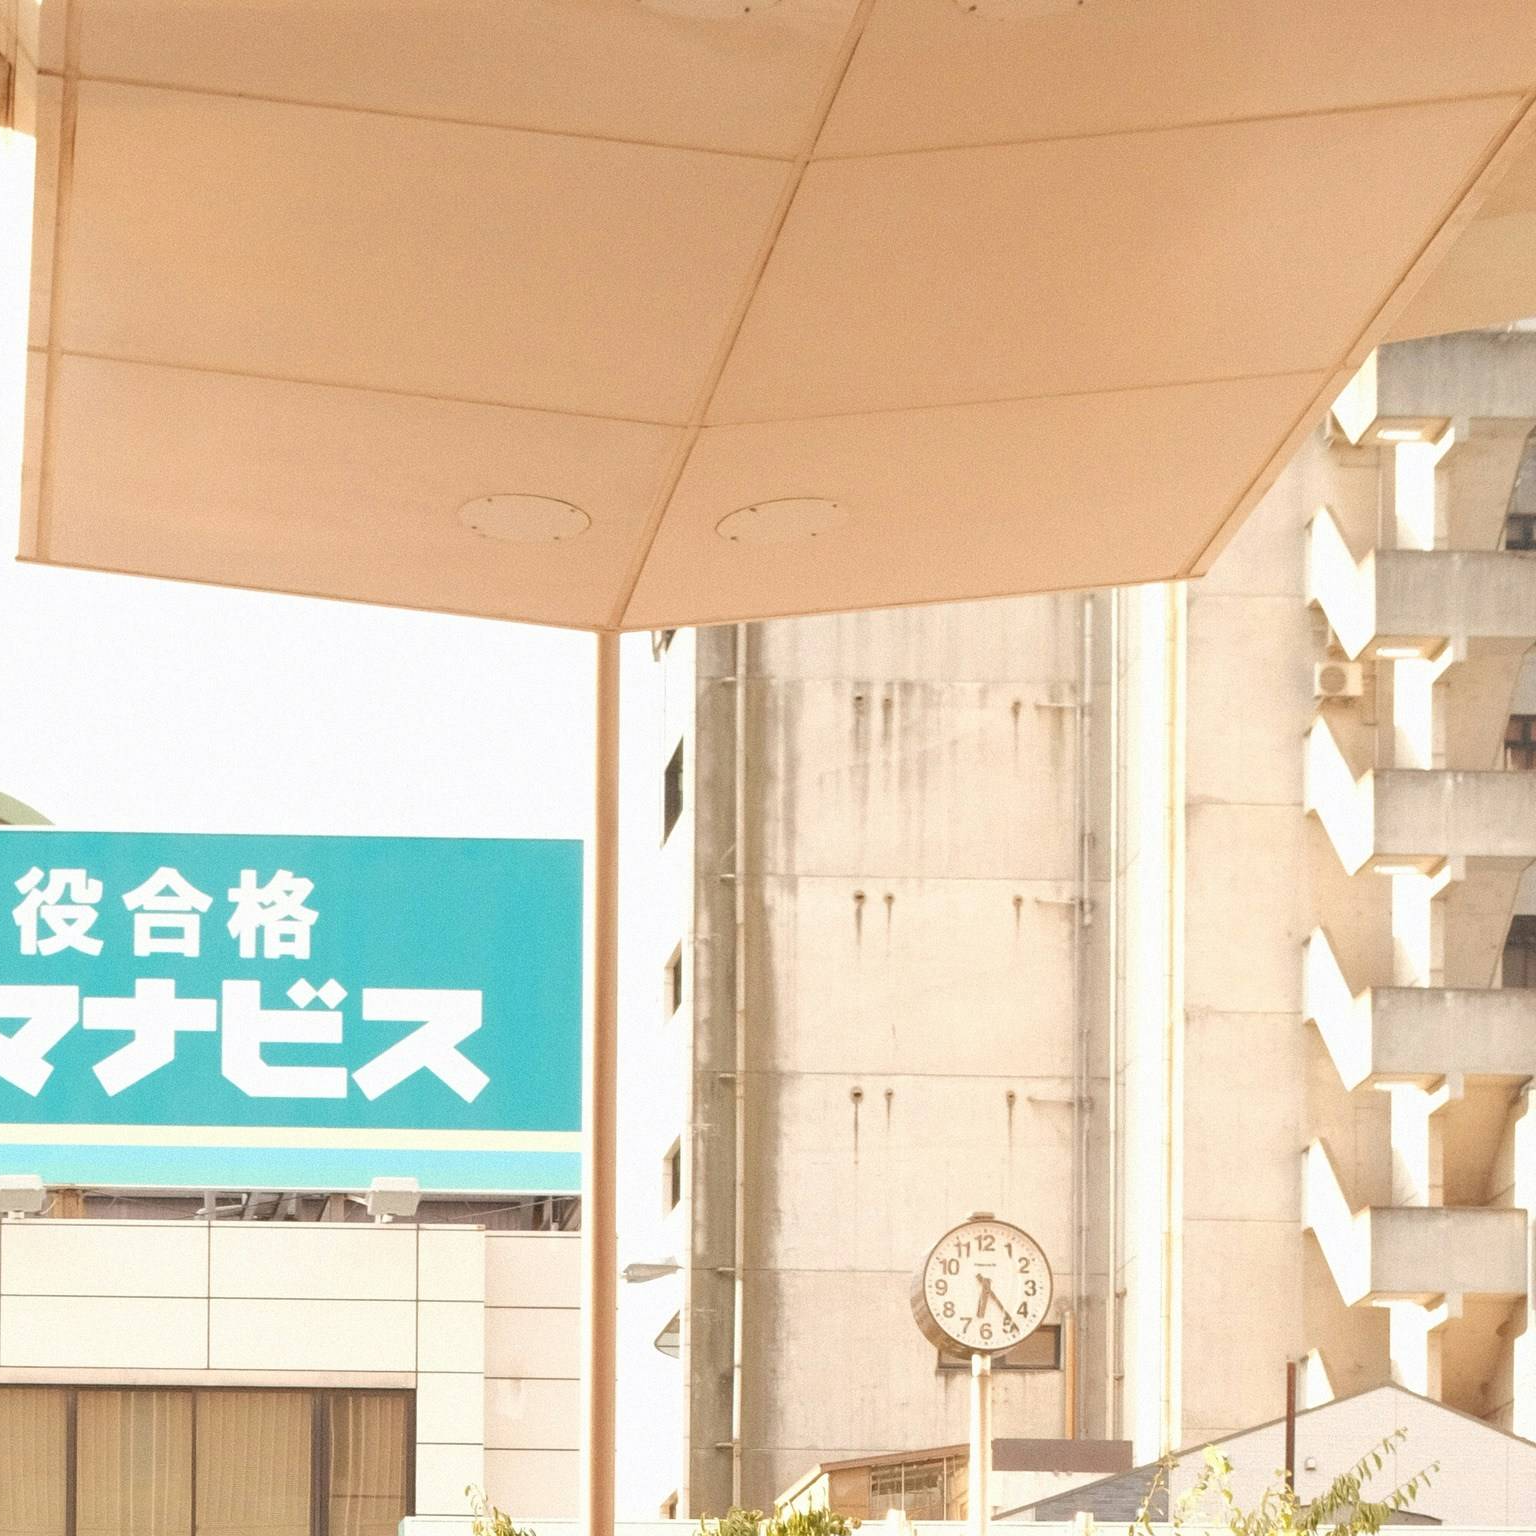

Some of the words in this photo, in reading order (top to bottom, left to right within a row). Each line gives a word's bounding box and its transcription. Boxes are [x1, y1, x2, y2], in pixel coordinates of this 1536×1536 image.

[954, 1241, 970, 1258] 11
[975, 1235, 995, 1251] 12
[939, 1259, 959, 1275] 10
[1018, 1257, 1030, 1273] 2
[935, 1279, 948, 1296] 9
[1024, 1280, 1037, 1296] 3
[943, 1301, 955, 1318] 8
[1017, 1301, 1028, 1318] 4
[960, 1317, 972, 1333] 7
[980, 1323, 993, 1340] 6
